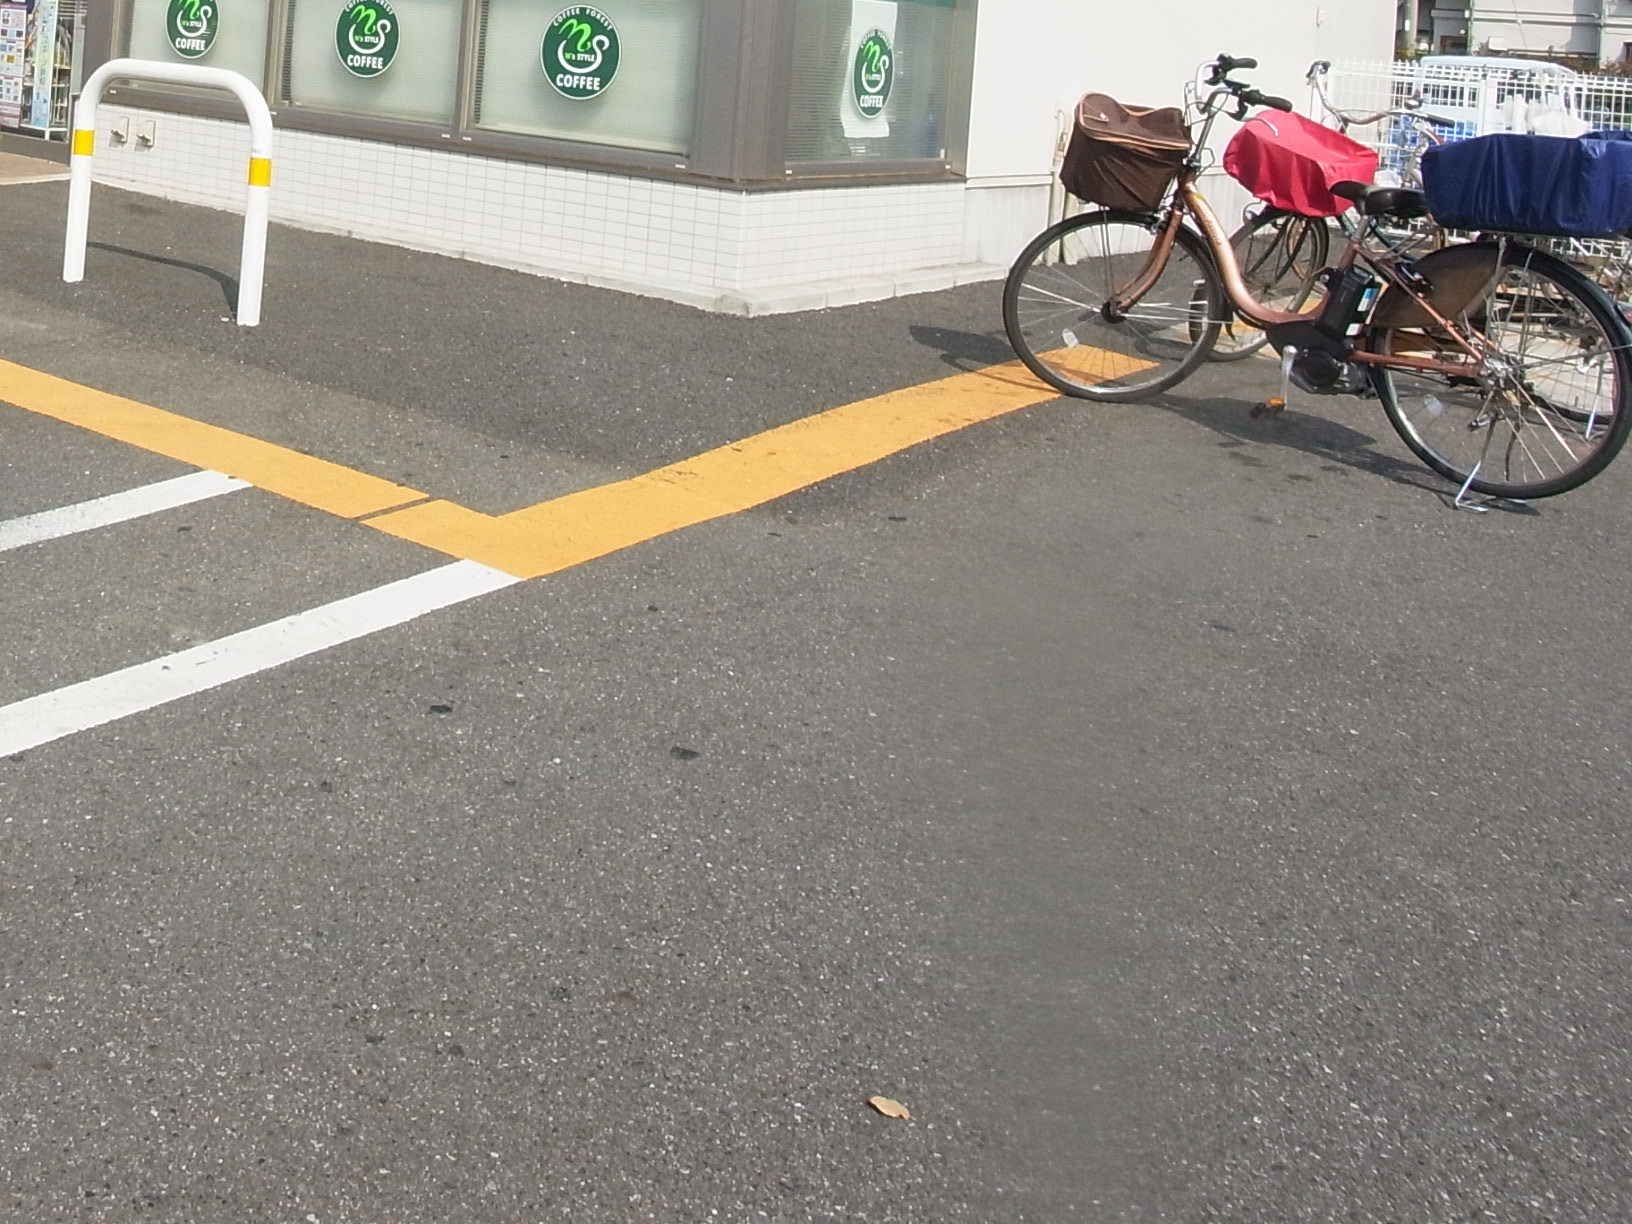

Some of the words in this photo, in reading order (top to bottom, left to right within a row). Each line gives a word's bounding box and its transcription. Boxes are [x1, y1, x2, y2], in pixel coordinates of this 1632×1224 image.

[553, 8, 580, 27] COFFEE
[586, 8, 614, 31] FOREST
[175, 37, 206, 51] COFFEE
[347, 54, 384, 69] COFFEE
[576, 53, 595, 62] STYLE
[556, 73, 601, 91] COFFEE
[860, 95, 883, 108] COFFEE
